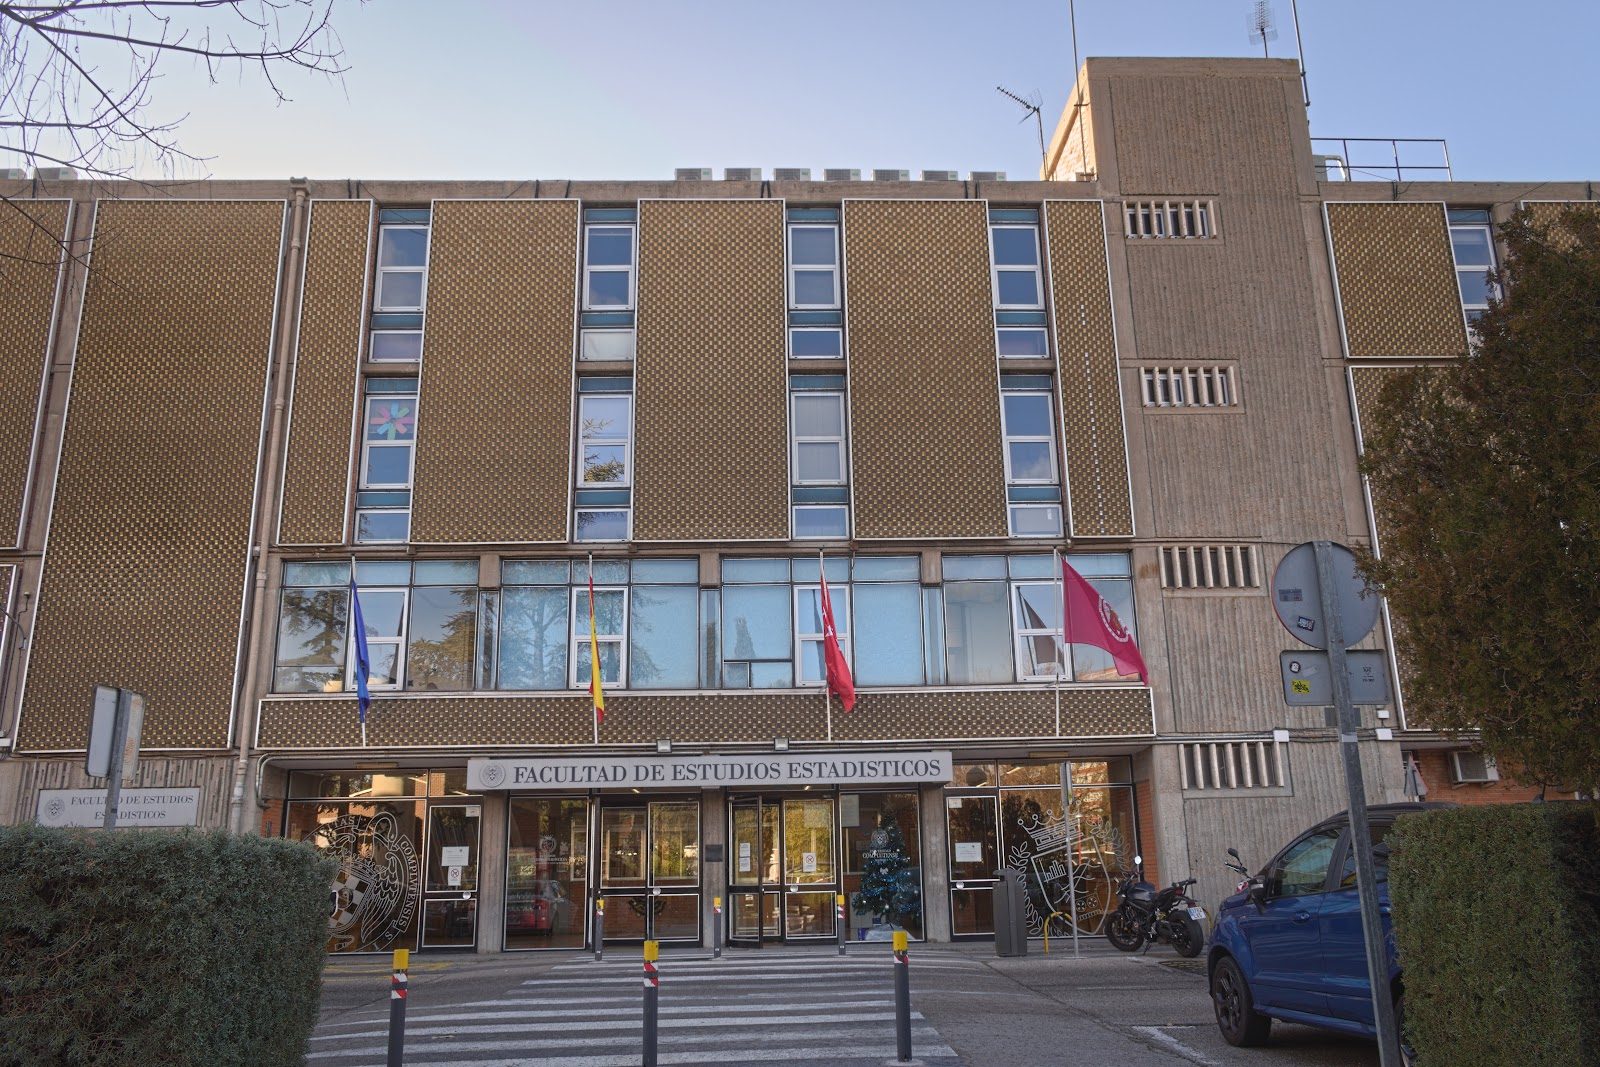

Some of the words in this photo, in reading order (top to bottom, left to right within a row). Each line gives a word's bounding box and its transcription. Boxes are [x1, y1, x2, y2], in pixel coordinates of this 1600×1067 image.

[513, 765, 627, 784] FACULTAD
[633, 764, 665, 782] DE
[671, 762, 781, 782] ESTUDIOS
[787, 759, 941, 779] ESTADISTICOS
[126, 796, 141, 804] DE
[143, 795, 193, 804] ESTUDIOS
[95, 811, 166, 820] ESDISTICOS
